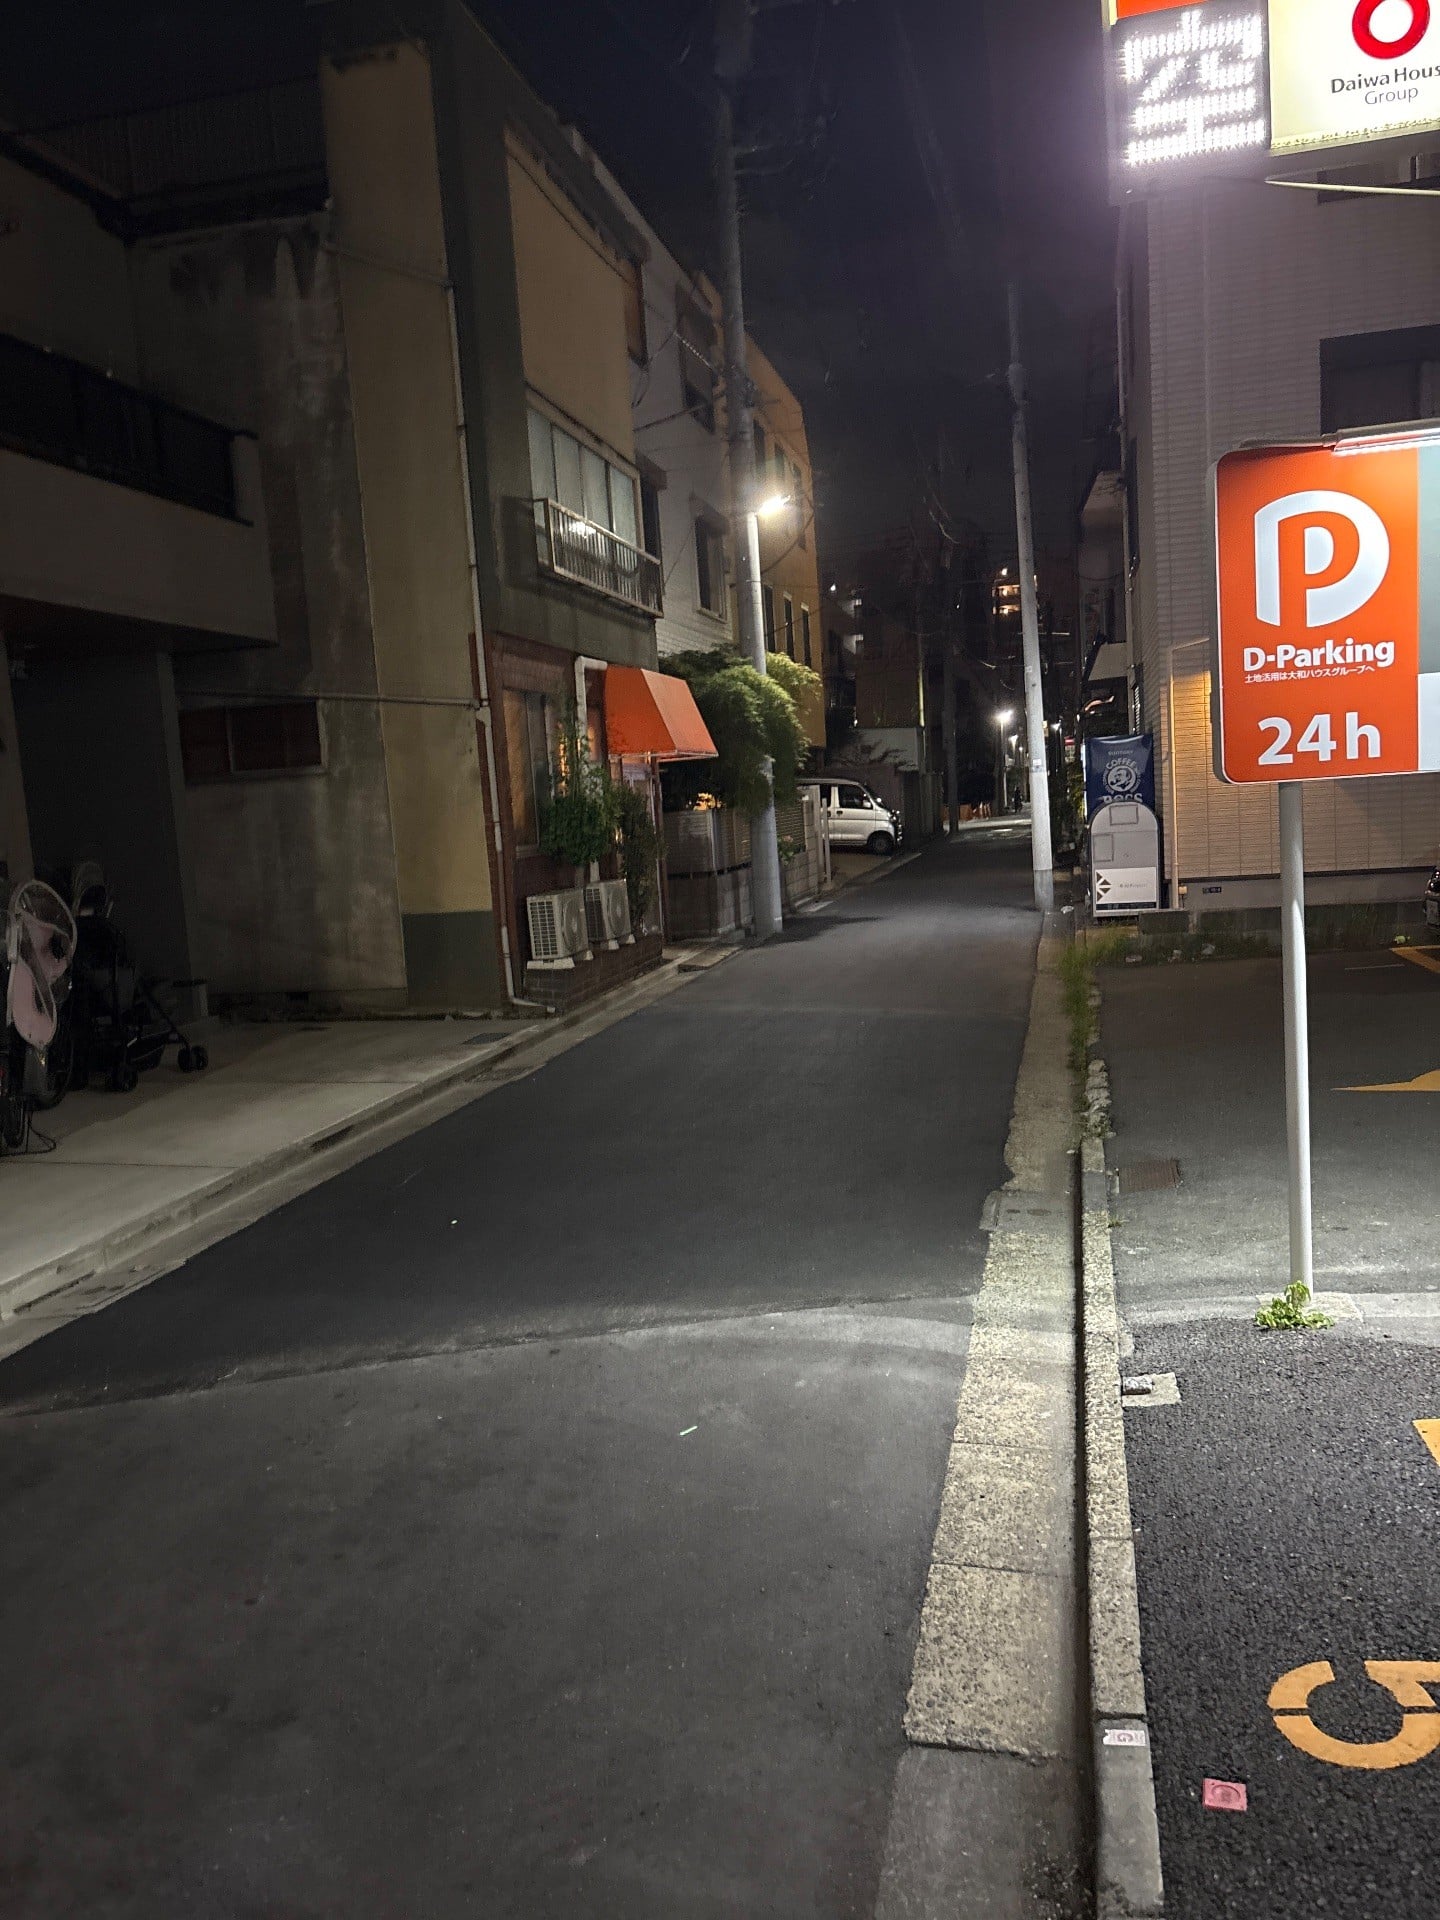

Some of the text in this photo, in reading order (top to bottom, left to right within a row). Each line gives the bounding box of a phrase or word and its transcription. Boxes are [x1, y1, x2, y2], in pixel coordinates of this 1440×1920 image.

[1124, 10, 1264, 166] 空
[1331, 73, 1390, 93] Daiwa
[1364, 87, 1418, 105] Group
[1243, 638, 1395, 672] D-Parking
